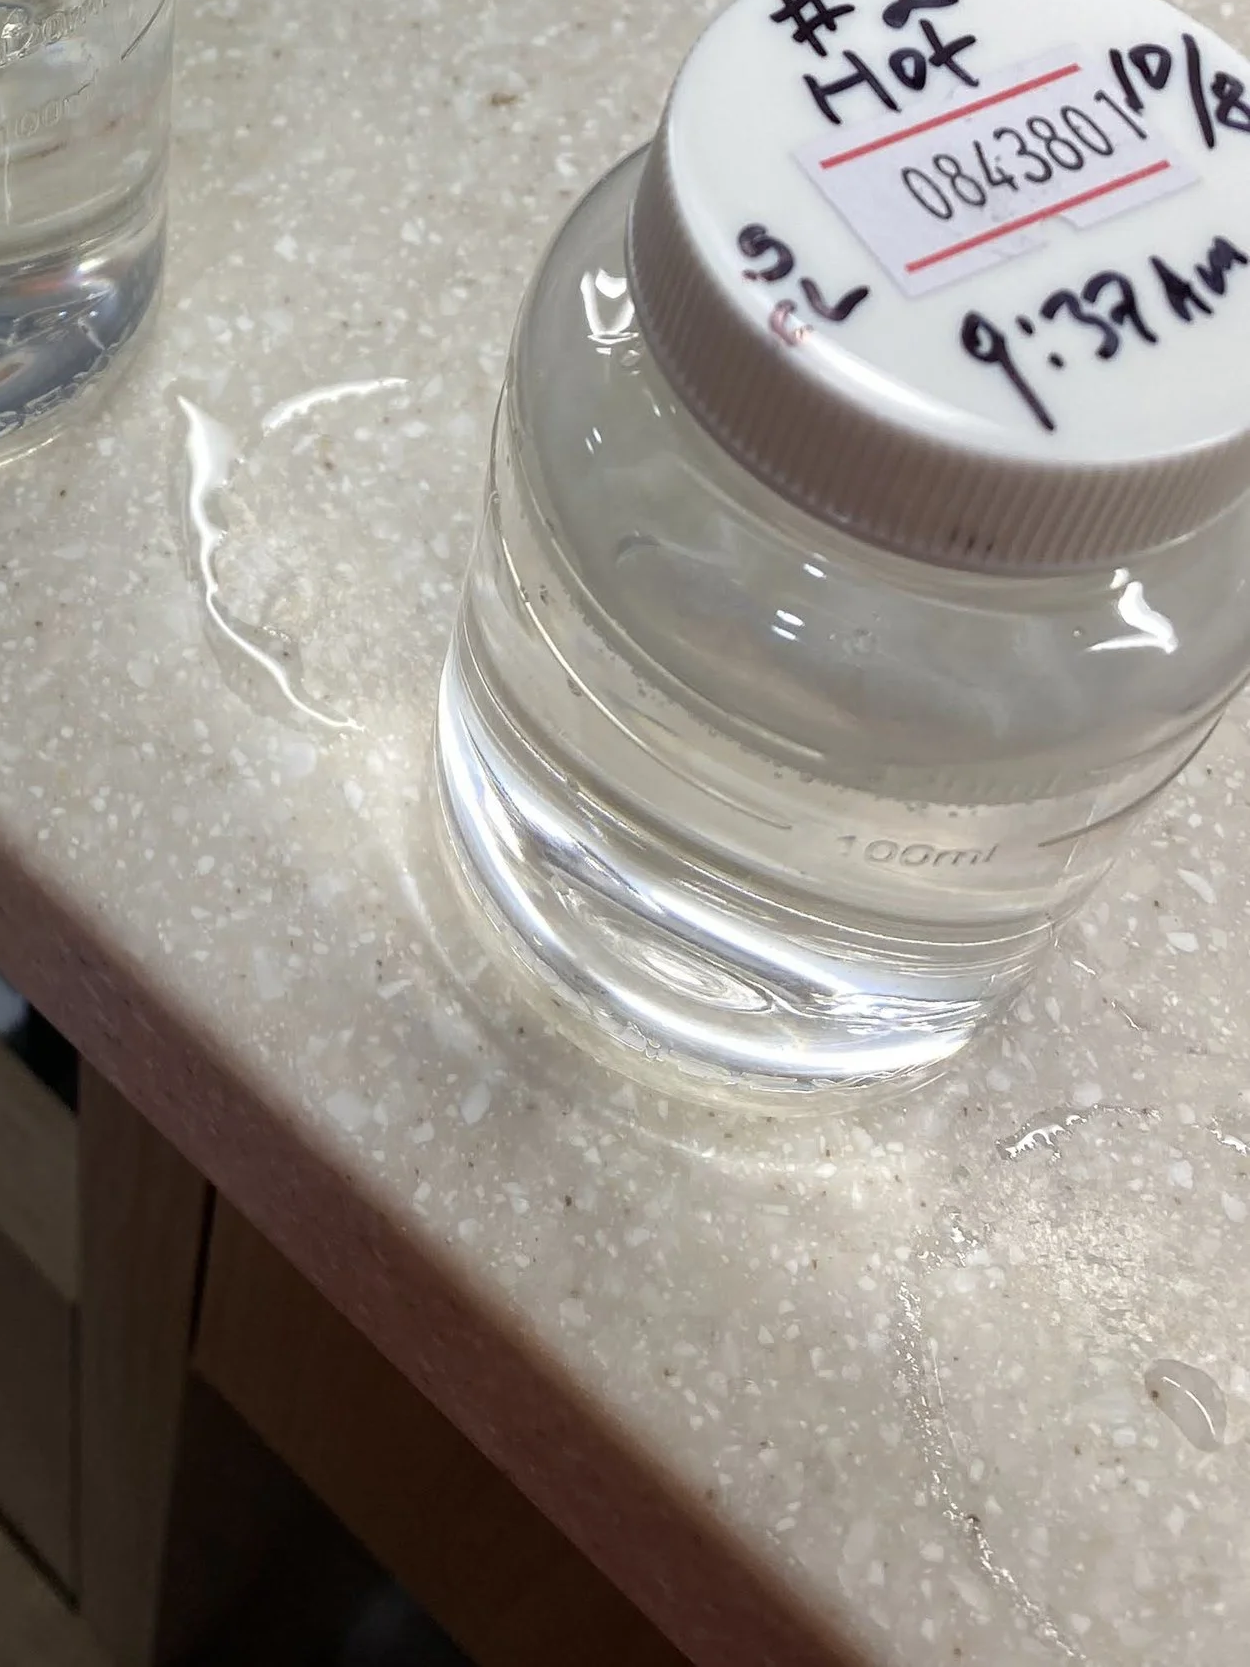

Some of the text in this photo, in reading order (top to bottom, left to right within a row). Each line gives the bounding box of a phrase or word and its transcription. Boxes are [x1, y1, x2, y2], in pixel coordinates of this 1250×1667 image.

[802, 18, 980, 125] Hot
[901, 89, 1148, 220] 0843801
[837, 833, 1000, 867] 100ml
